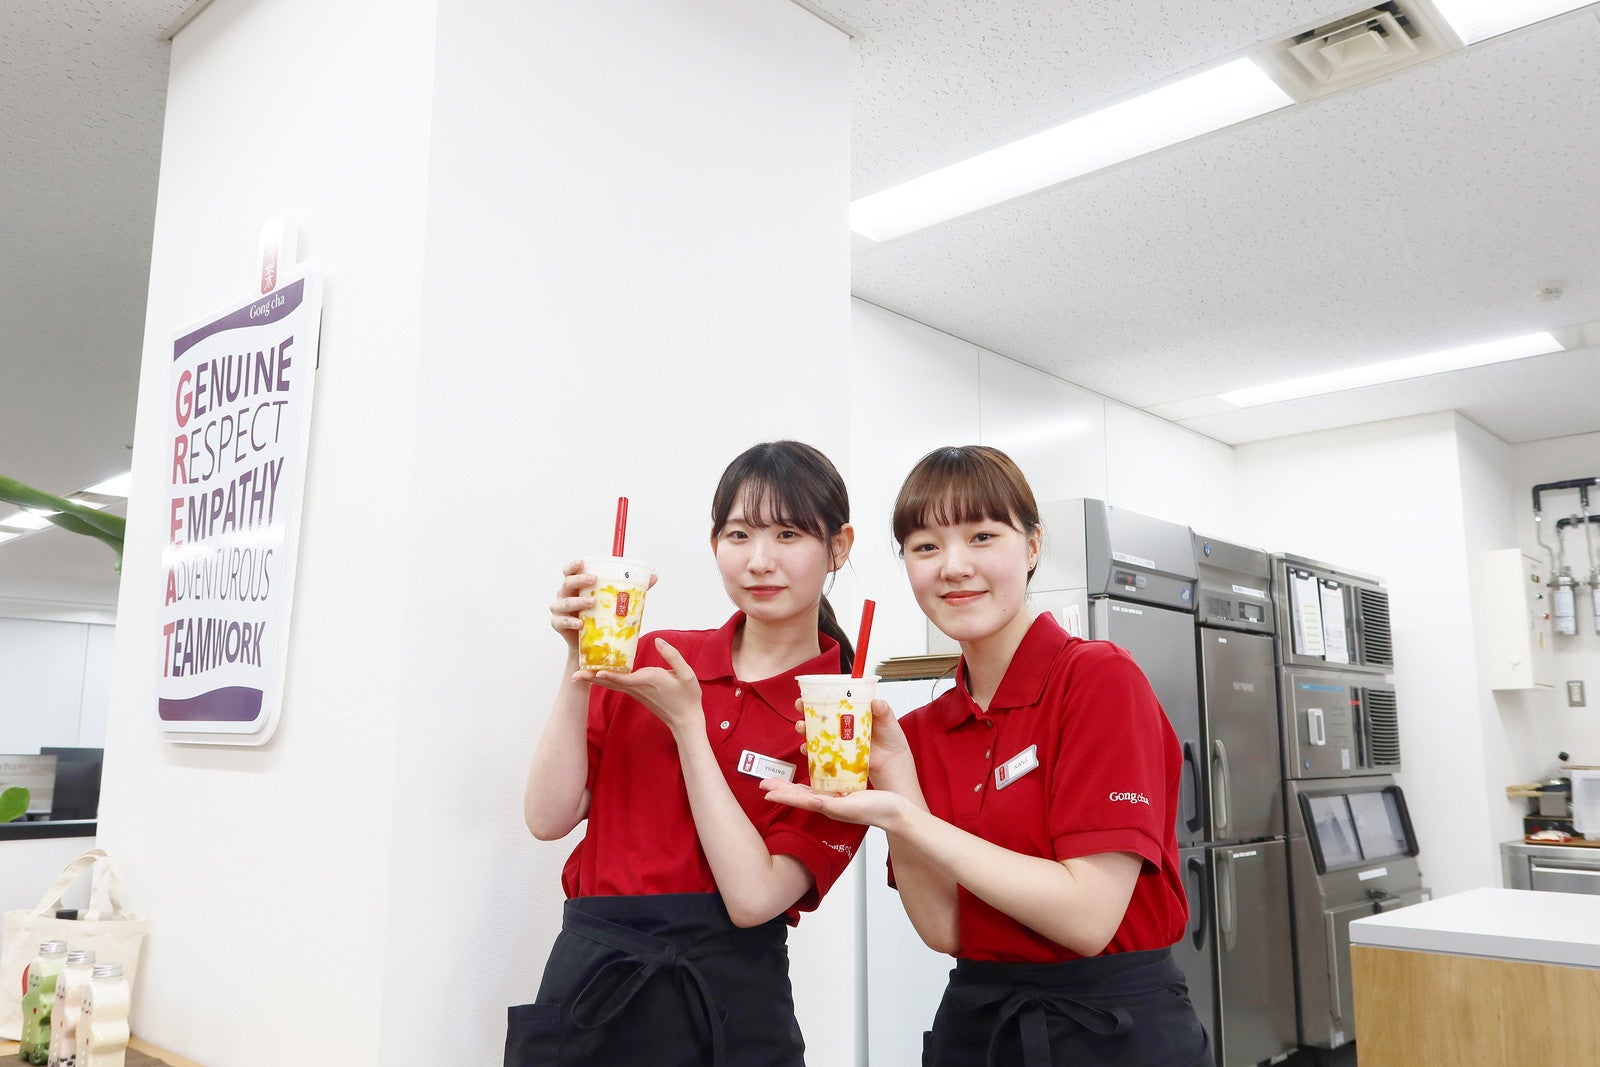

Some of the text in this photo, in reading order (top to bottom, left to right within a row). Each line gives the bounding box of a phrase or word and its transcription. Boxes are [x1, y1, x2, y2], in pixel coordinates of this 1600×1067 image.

[250, 293, 285, 319] Gong cha
[175, 335, 294, 428] GENUINE
[172, 400, 289, 485] RESPECT
[170, 456, 284, 546] EMPATHY
[164, 547, 273, 607] ADVENTUROUS
[624, 571, 630, 579] 6
[163, 617, 266, 678] TEAMWORK
[1109, 791, 1150, 805] Gong cha
